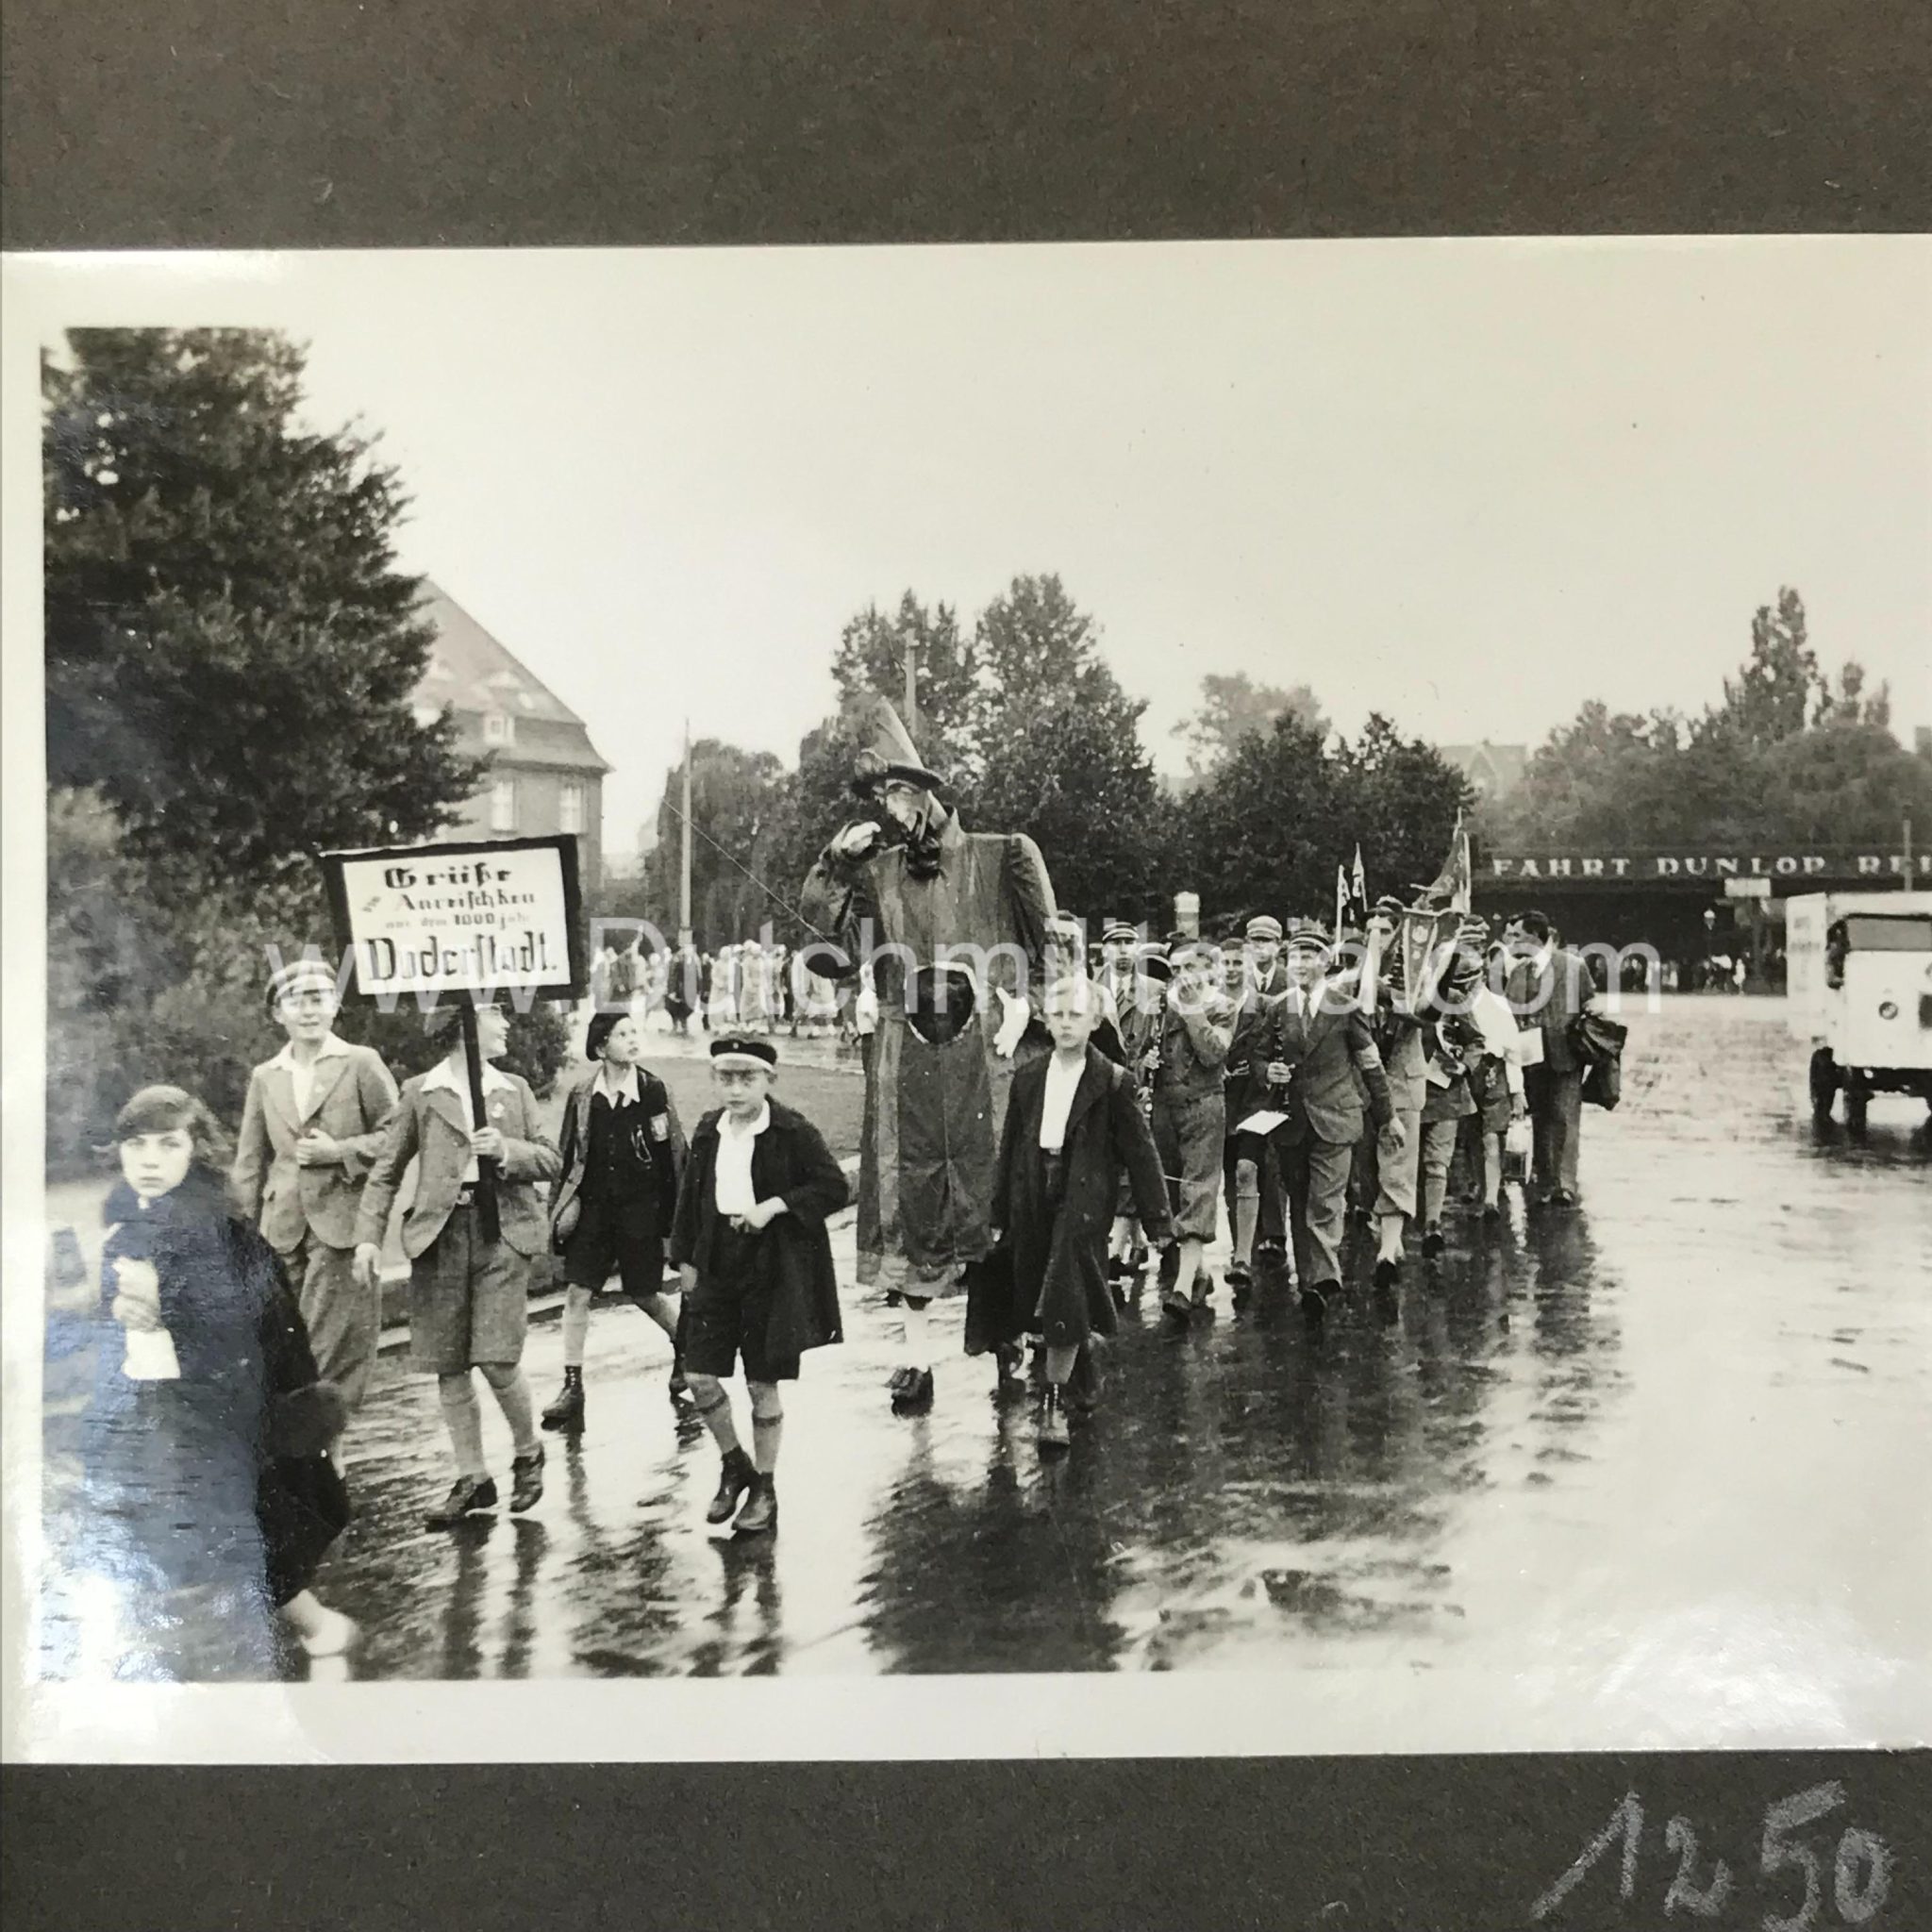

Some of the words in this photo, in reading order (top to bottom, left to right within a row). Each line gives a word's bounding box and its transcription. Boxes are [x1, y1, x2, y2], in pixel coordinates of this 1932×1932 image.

[1492, 858, 1631, 876] FAHRT
[1657, 857, 1826, 876] DUNLOP
[1531, 1779, 1894, 1932] 1250
